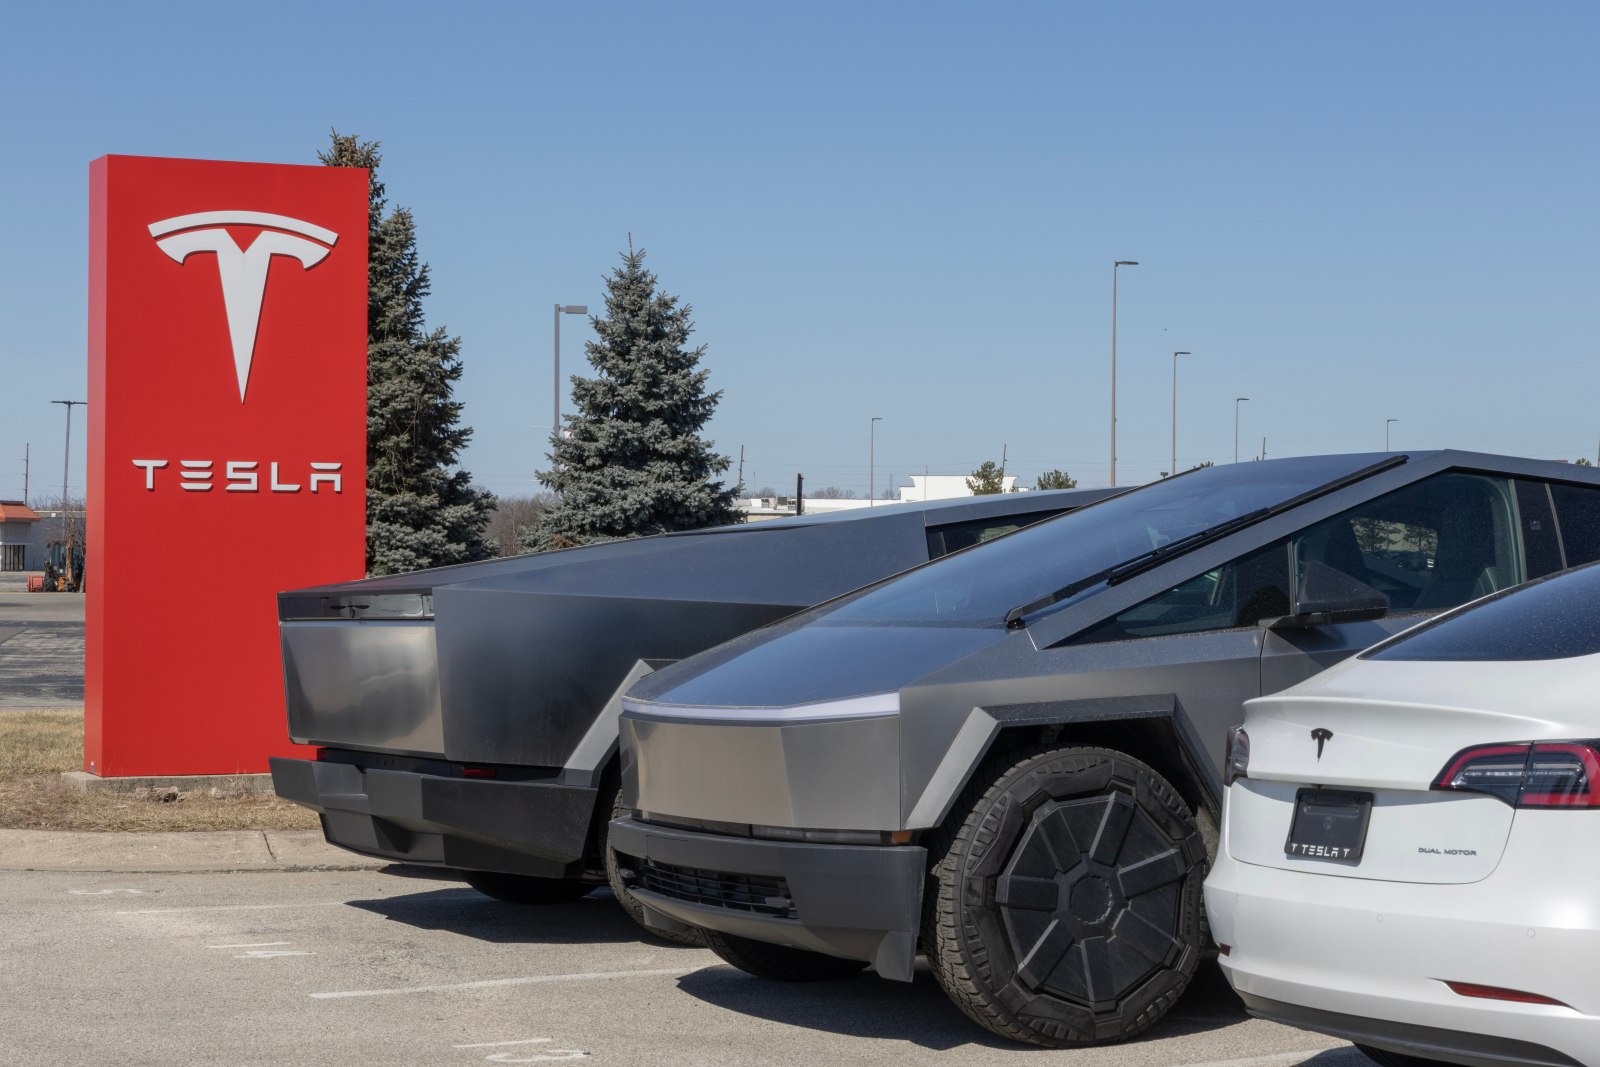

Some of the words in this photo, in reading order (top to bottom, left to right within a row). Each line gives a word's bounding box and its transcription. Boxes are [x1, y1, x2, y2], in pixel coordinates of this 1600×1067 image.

[131, 459, 343, 493] TESLA
[1301, 844, 1340, 859] TESLA
[1417, 847, 1442, 856] DUAL
[1443, 848, 1477, 857] MOTOR
